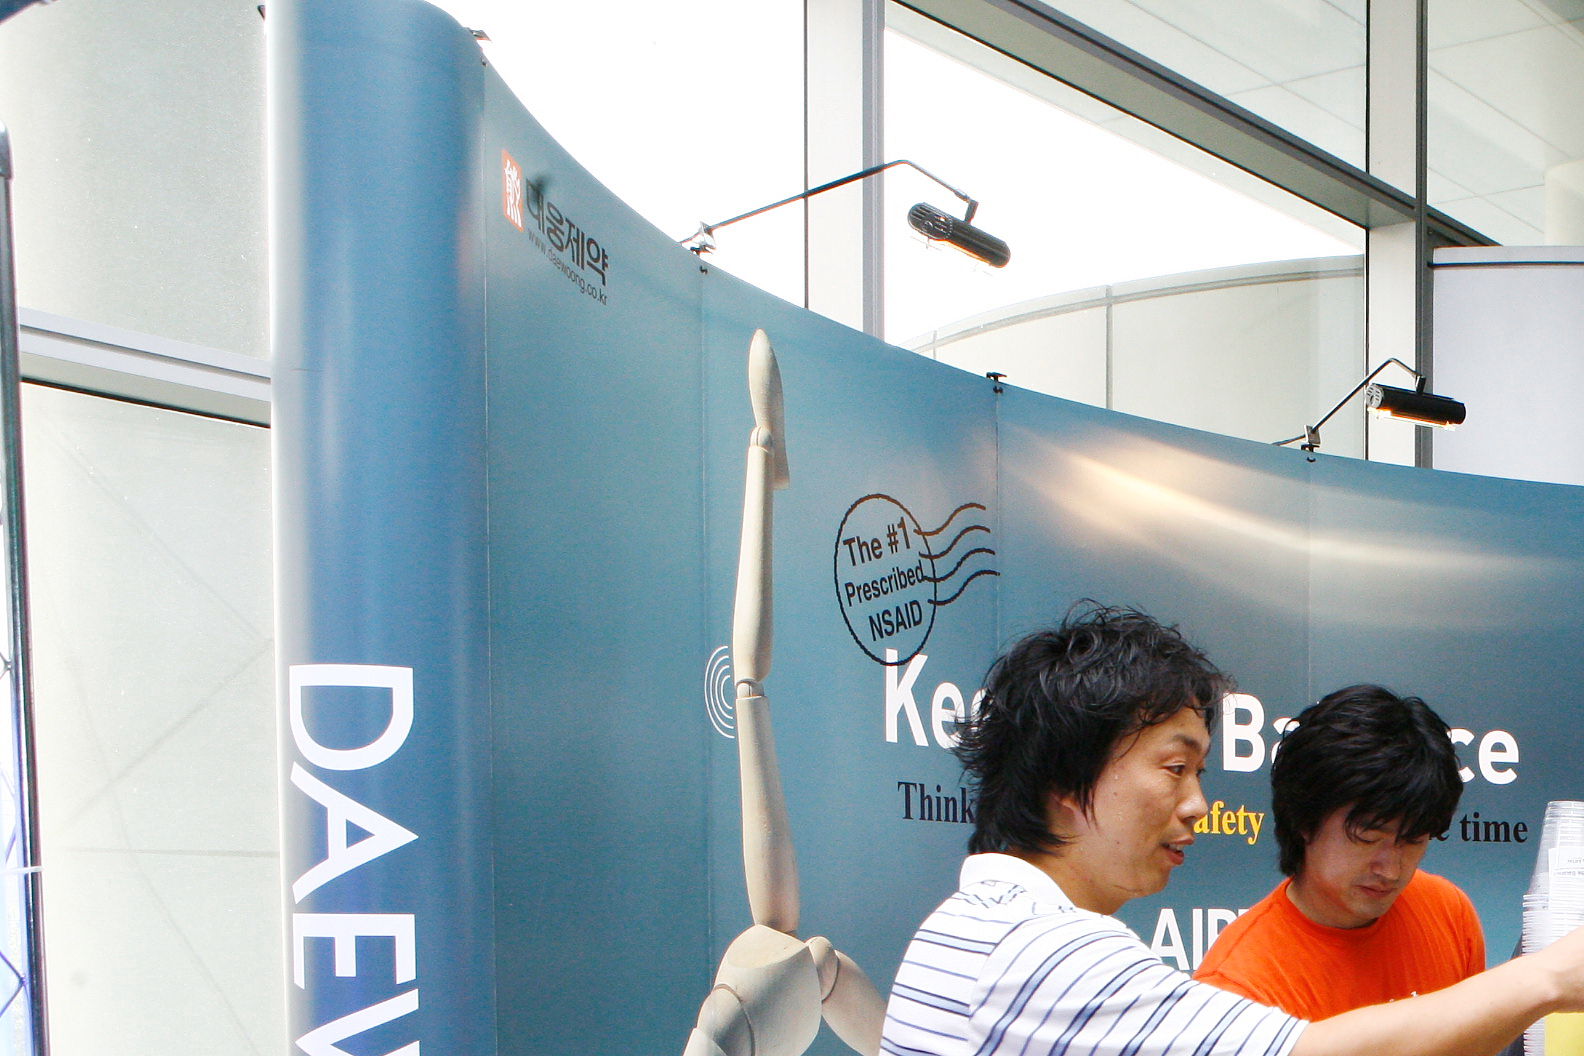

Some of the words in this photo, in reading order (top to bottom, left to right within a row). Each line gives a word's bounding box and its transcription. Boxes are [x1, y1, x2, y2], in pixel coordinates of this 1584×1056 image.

[843, 536, 883, 566] The
[887, 517, 911, 554] #1
[845, 560, 925, 607] Prescribed
[869, 600, 923, 641] NSAID
[1194, 801, 1264, 844] afety
[1459, 811, 1528, 843] time
